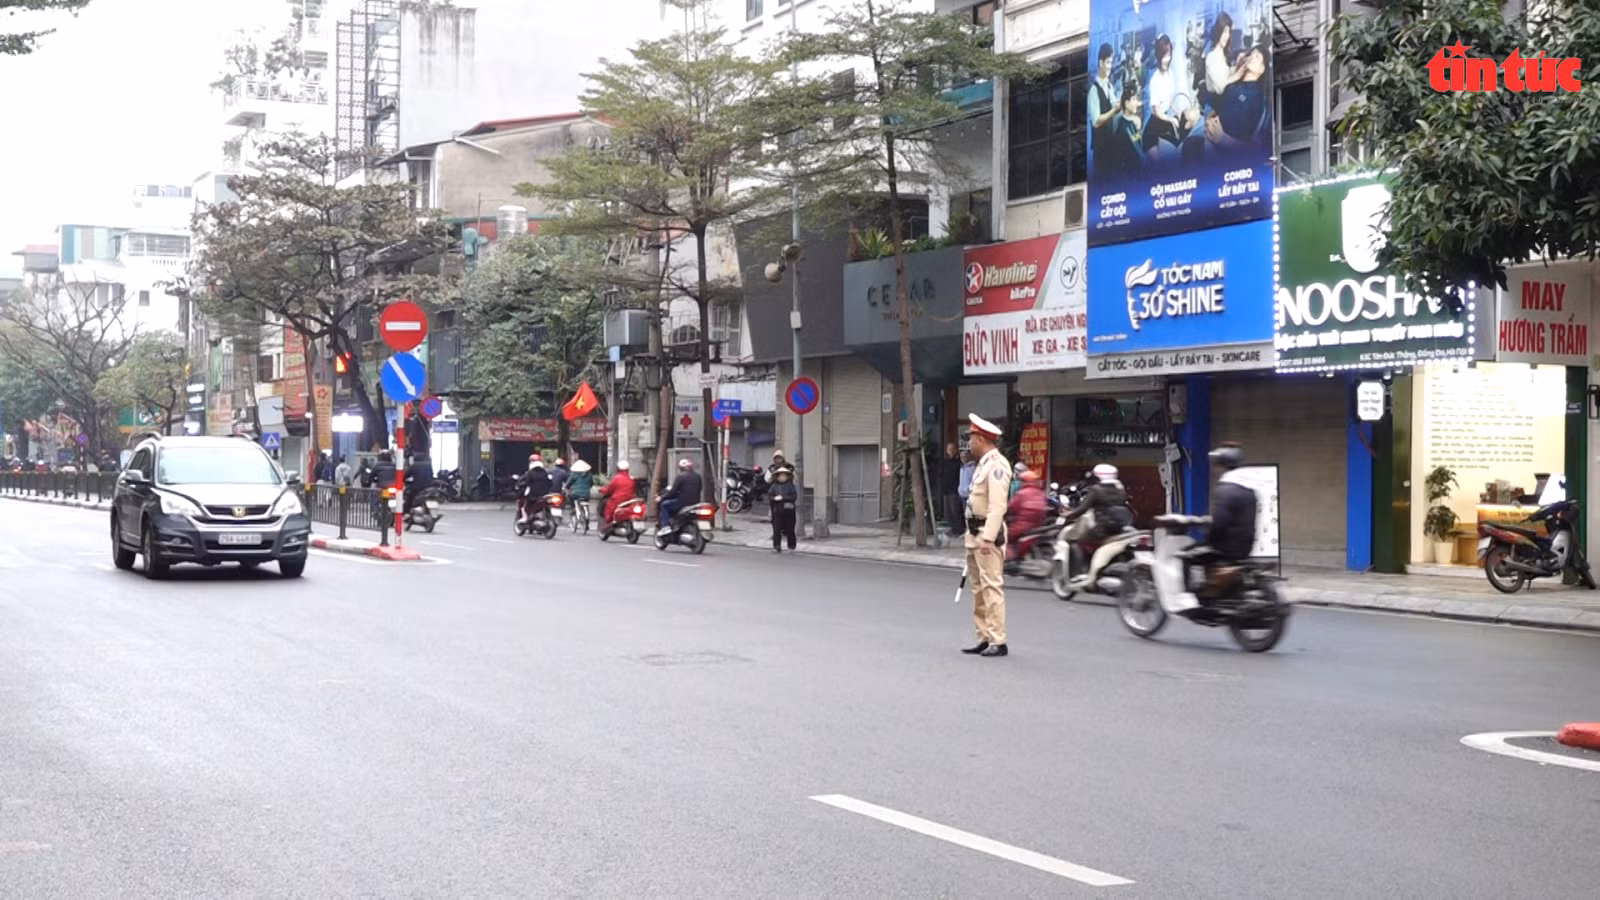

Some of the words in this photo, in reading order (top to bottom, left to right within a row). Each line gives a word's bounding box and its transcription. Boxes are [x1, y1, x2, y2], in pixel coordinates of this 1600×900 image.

[1224, 168, 1253, 182] COMBO
[1165, 179, 1198, 195] MASSAGE
[1101, 192, 1126, 206] COMBO
[983, 261, 1038, 288] Havoline
[1192, 259, 1225, 281] NAM
[1166, 284, 1225, 317] SHINE
[1521, 280, 1566, 312] MAY
[964, 322, 988, 367] ĐỨC
[990, 327, 1020, 366] VINH
[1032, 338, 1044, 354] XE
[1045, 338, 1059, 353] GA
[1066, 335, 1079, 352] XE
[1499, 317, 1546, 354] HƯƠNG
[1202, 354, 1214, 364] TAI
[1221, 350, 1262, 364] SKINCARE
